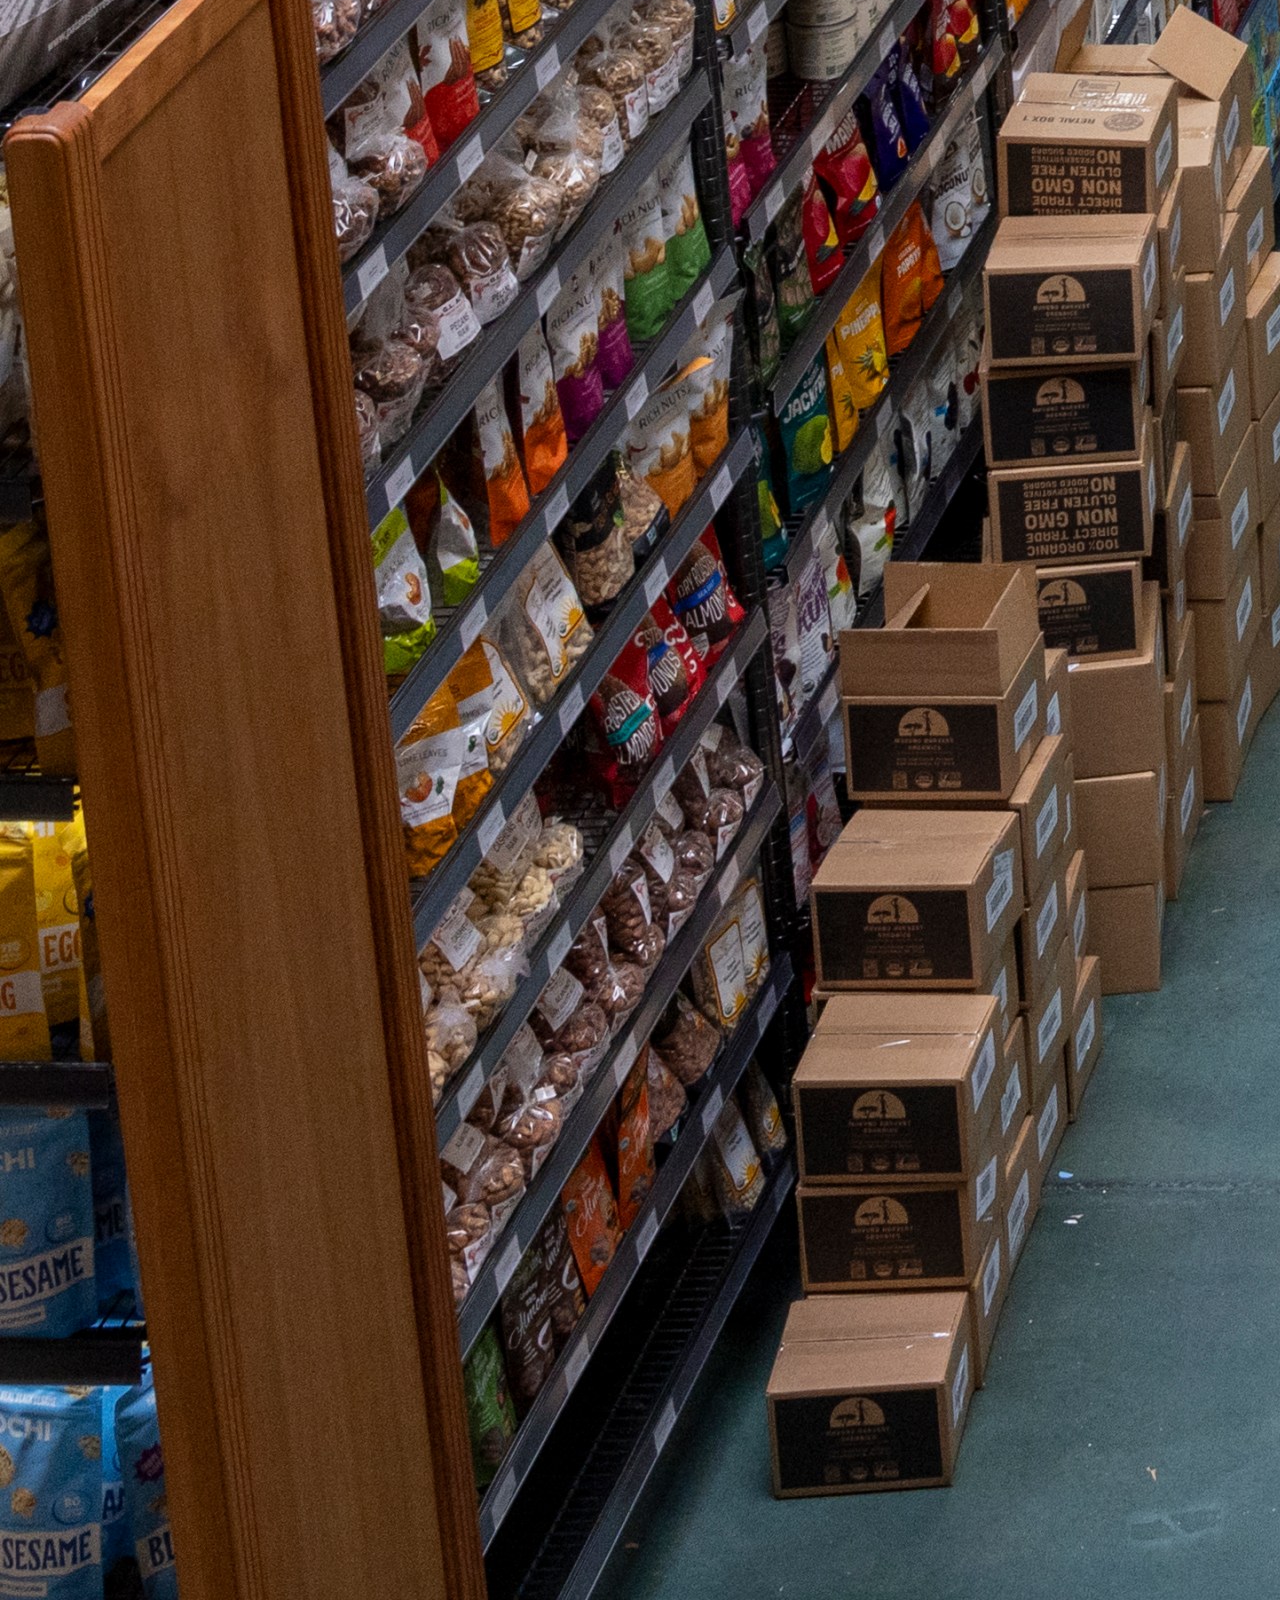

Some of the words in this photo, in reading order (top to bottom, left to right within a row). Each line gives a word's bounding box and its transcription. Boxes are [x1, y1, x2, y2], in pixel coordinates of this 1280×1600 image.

[1032, 114, 1054, 124] BOX
[1060, 116, 1096, 126] RETAIL
[1095, 150, 1122, 167] NO
[1031, 164, 1066, 177] FREE
[1073, 164, 1122, 178] GLUTEN
[1031, 178, 1076, 195] GMO
[1081, 179, 1123, 196] NON
[1032, 195, 1071, 207] TRADE
[1074, 196, 1123, 209] DIRECT
[1090, 475, 1116, 492] NO
[1023, 498, 1059, 512] FREE
[1063, 493, 1117, 508] GLUTEN
[1024, 511, 1069, 531] GMO
[1075, 506, 1118, 527] NON
[1025, 530, 1069, 544] TRADE
[1072, 525, 1119, 538] DIRECT
[1026, 541, 1086, 557] ORGANIC
[1088, 538, 1120, 551] 100%
[1, 1529, 94, 1574] SESAME
